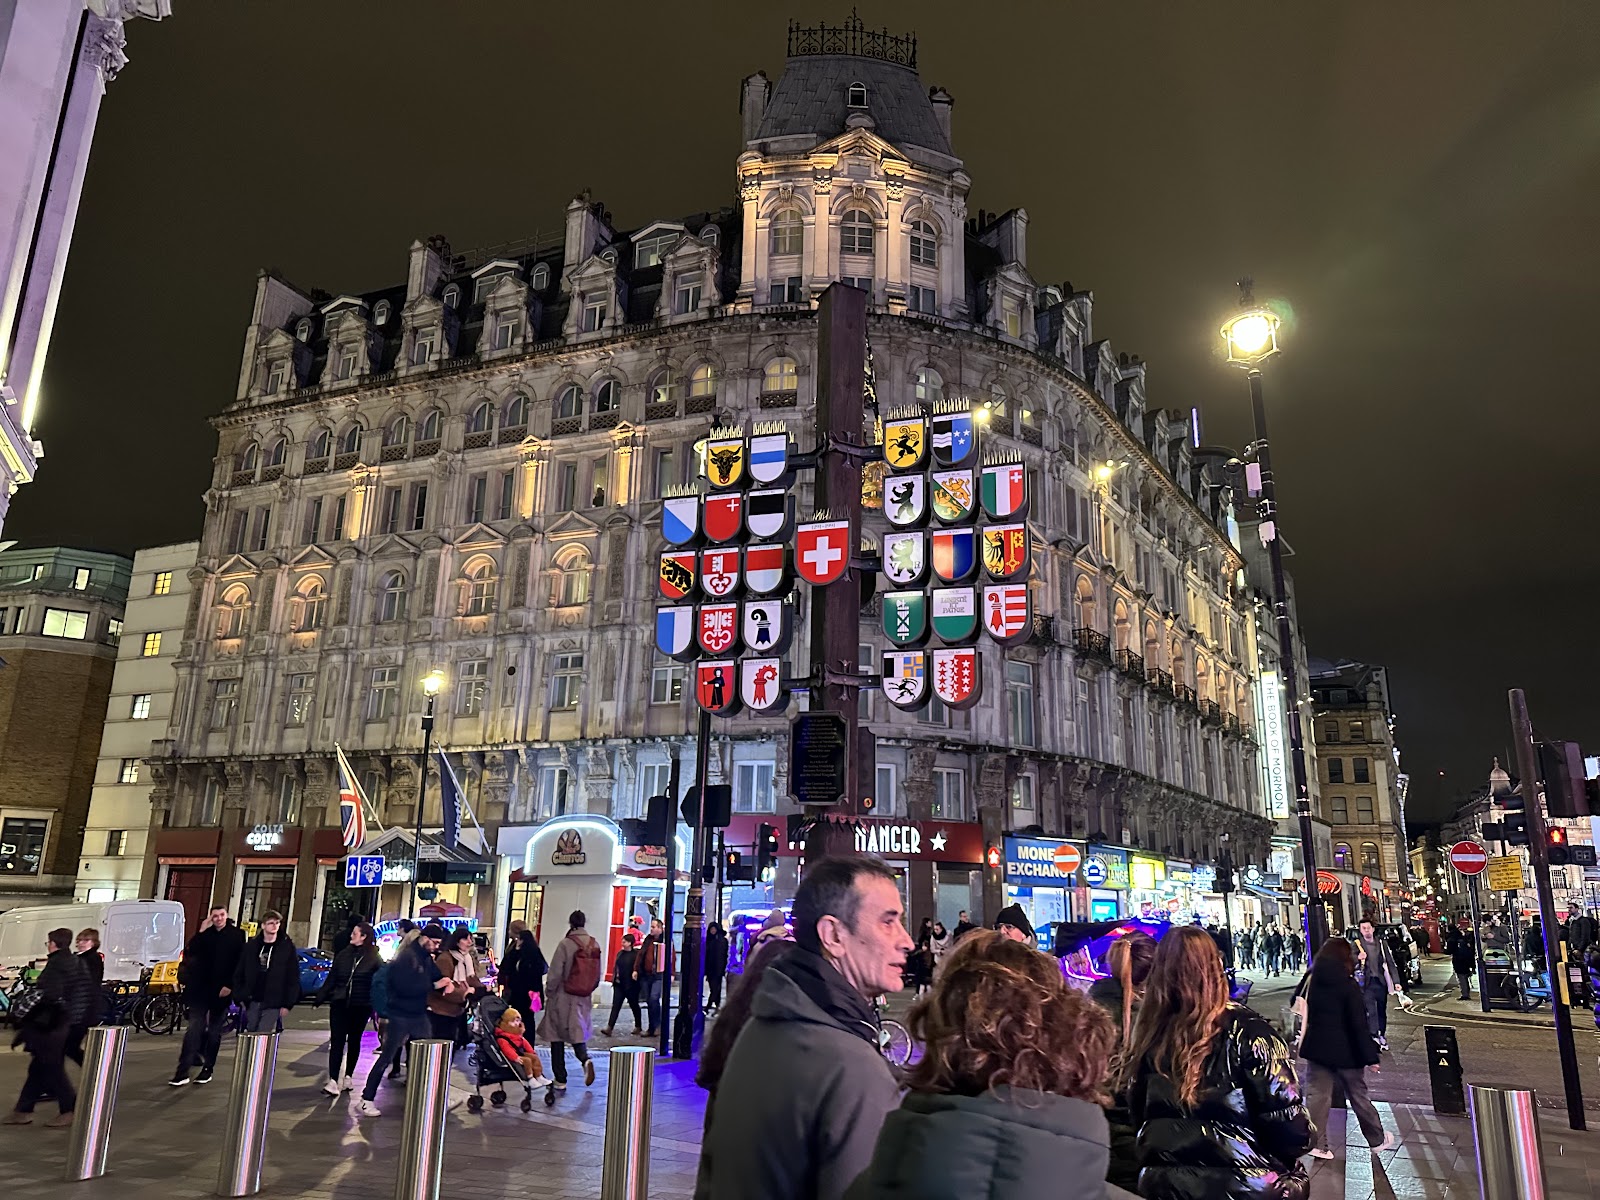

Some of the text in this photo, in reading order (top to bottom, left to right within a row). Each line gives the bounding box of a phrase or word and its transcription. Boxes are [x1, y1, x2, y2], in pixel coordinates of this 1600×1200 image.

[1266, 681, 1275, 702] THE
[1267, 705, 1278, 736] BOOK
[1270, 739, 1280, 754] OF
[1272, 758, 1284, 810] MORMON
[246, 832, 279, 845] COSTA
[1017, 846, 1055, 862] MONE
[382, 864, 411, 882] istle
[1007, 862, 1076, 879] EXCHAN
